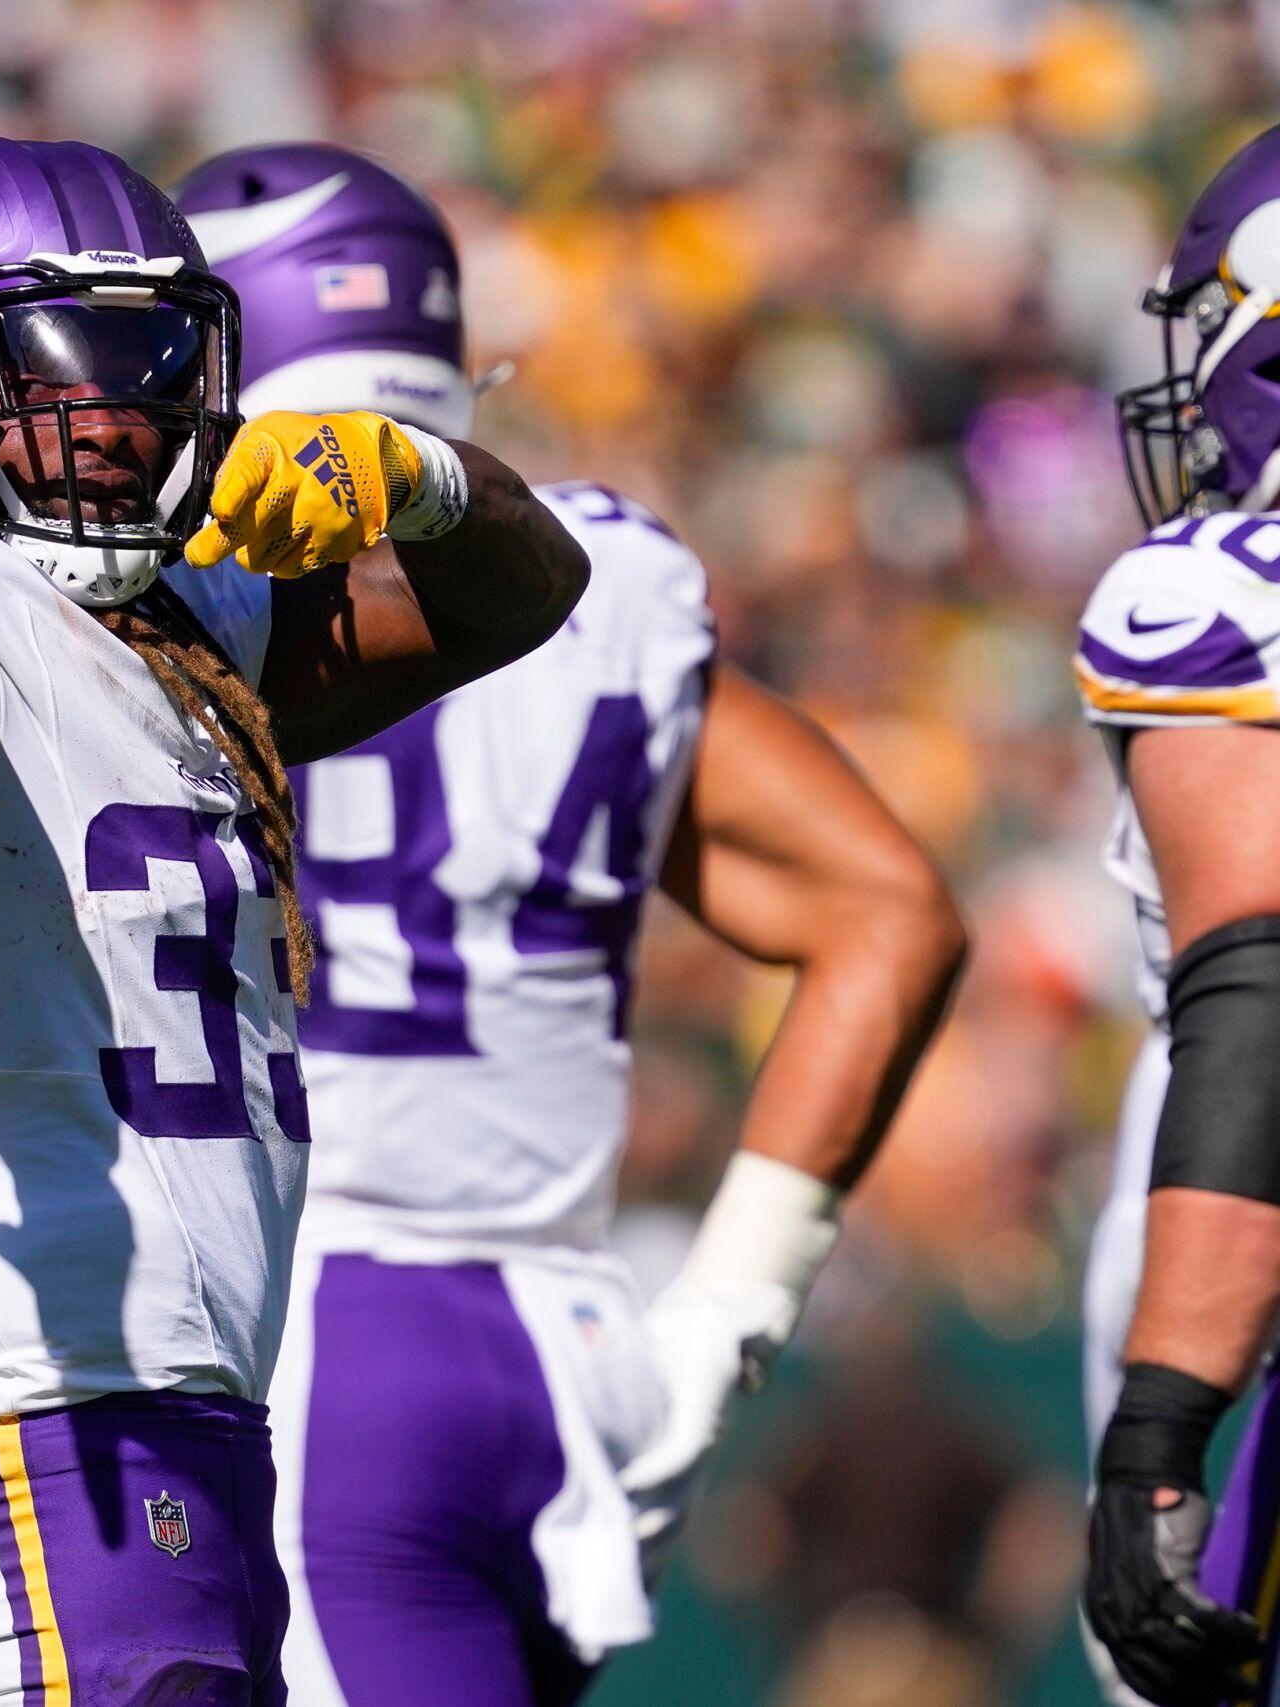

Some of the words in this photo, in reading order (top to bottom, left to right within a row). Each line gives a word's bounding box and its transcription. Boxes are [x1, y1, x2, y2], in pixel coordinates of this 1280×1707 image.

[318, 424, 359, 517] adidas
[285, 693, 646, 1058] 84
[157, 1520, 185, 1545] NFL
